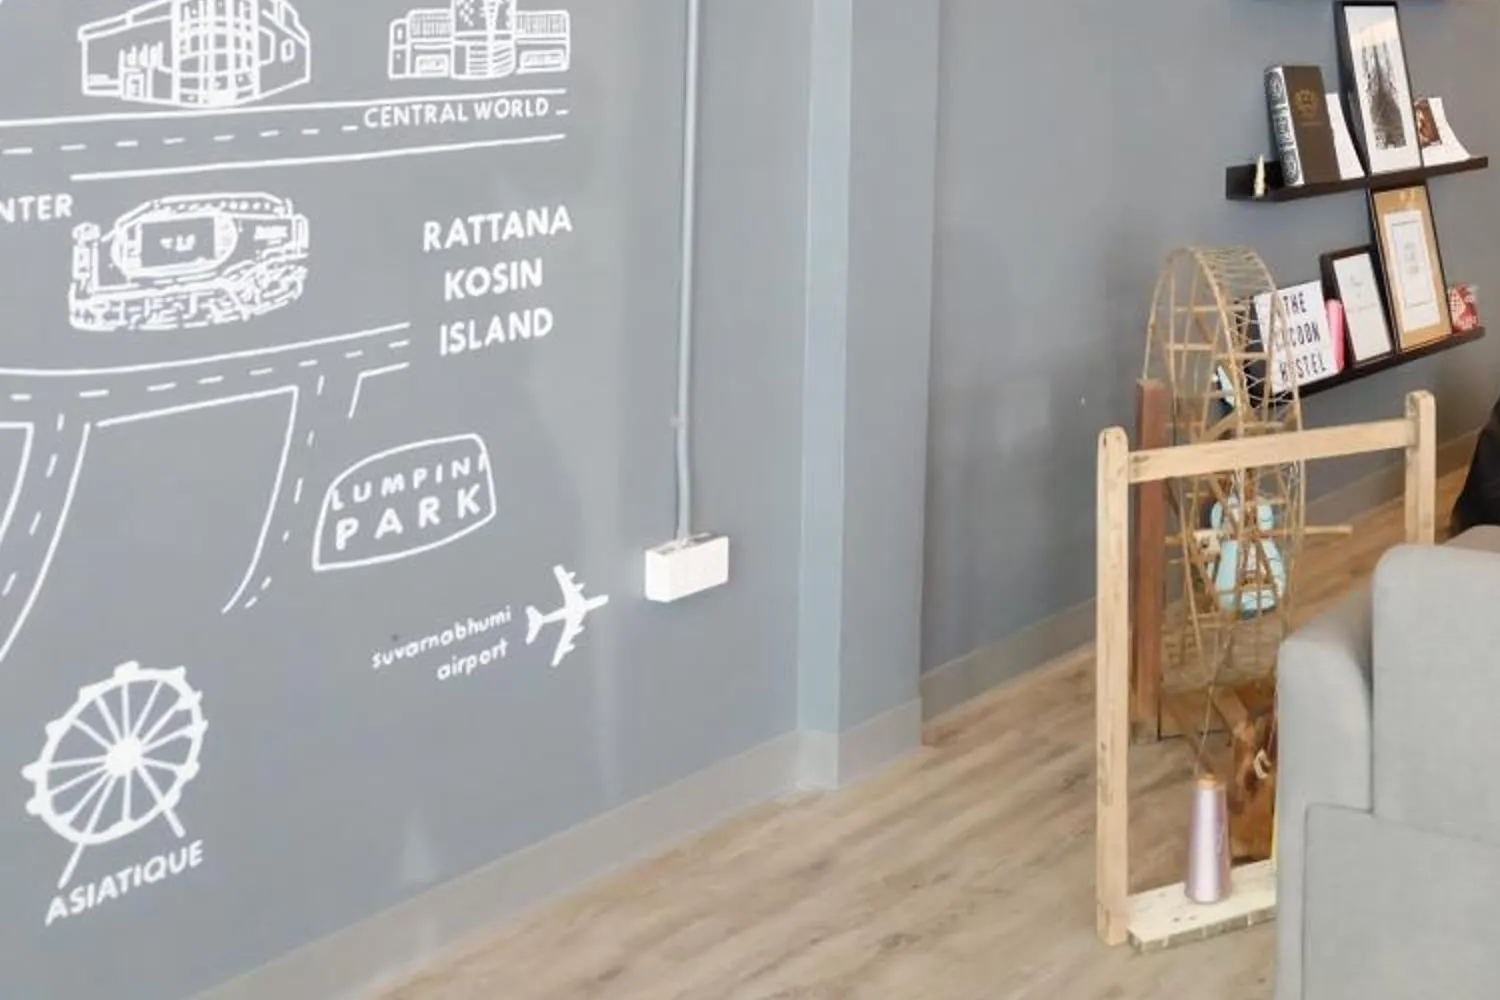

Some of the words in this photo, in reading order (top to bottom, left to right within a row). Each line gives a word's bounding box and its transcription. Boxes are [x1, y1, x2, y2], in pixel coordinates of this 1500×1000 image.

[364, 105, 468, 129] CENTRAL
[473, 96, 549, 121] WORLD
[423, 205, 573, 253] RATTANA
[445, 257, 543, 302] KOSIN
[1283, 291, 1308, 316] THE
[440, 308, 554, 357] ISLAND
[332, 451, 487, 511] LUMPINI
[335, 483, 481, 551] PARK
[372, 606, 512, 669] suvarnabhumi
[436, 637, 509, 681] airport
[45, 840, 204, 927] ASIATIQUE
